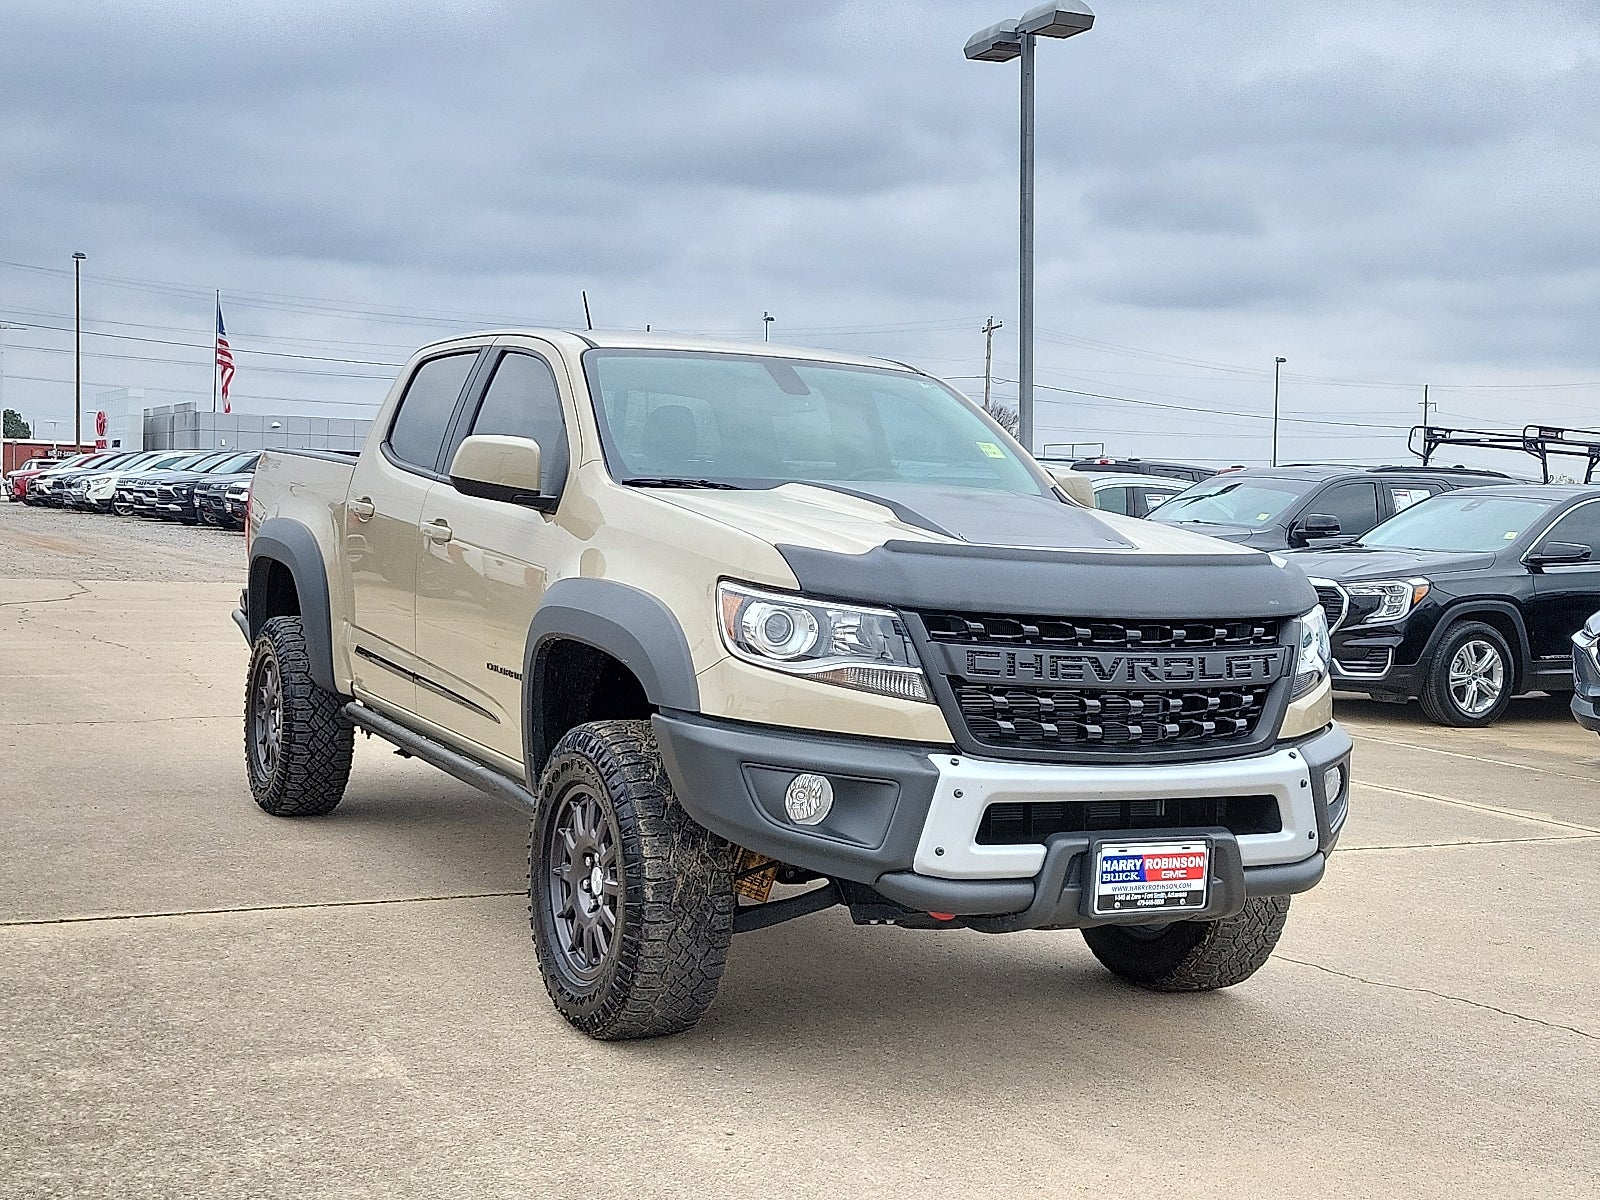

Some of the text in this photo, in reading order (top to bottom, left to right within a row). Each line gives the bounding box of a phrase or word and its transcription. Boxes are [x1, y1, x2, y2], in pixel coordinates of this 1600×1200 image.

[966, 650, 1278, 682] CHEVROLET
[1102, 856, 1204, 871] HARRY ROBINSON
[1102, 870, 1187, 882] BUICK GMC
[1112, 883, 1192, 892] WWW.HARRYROBINSON.COM
